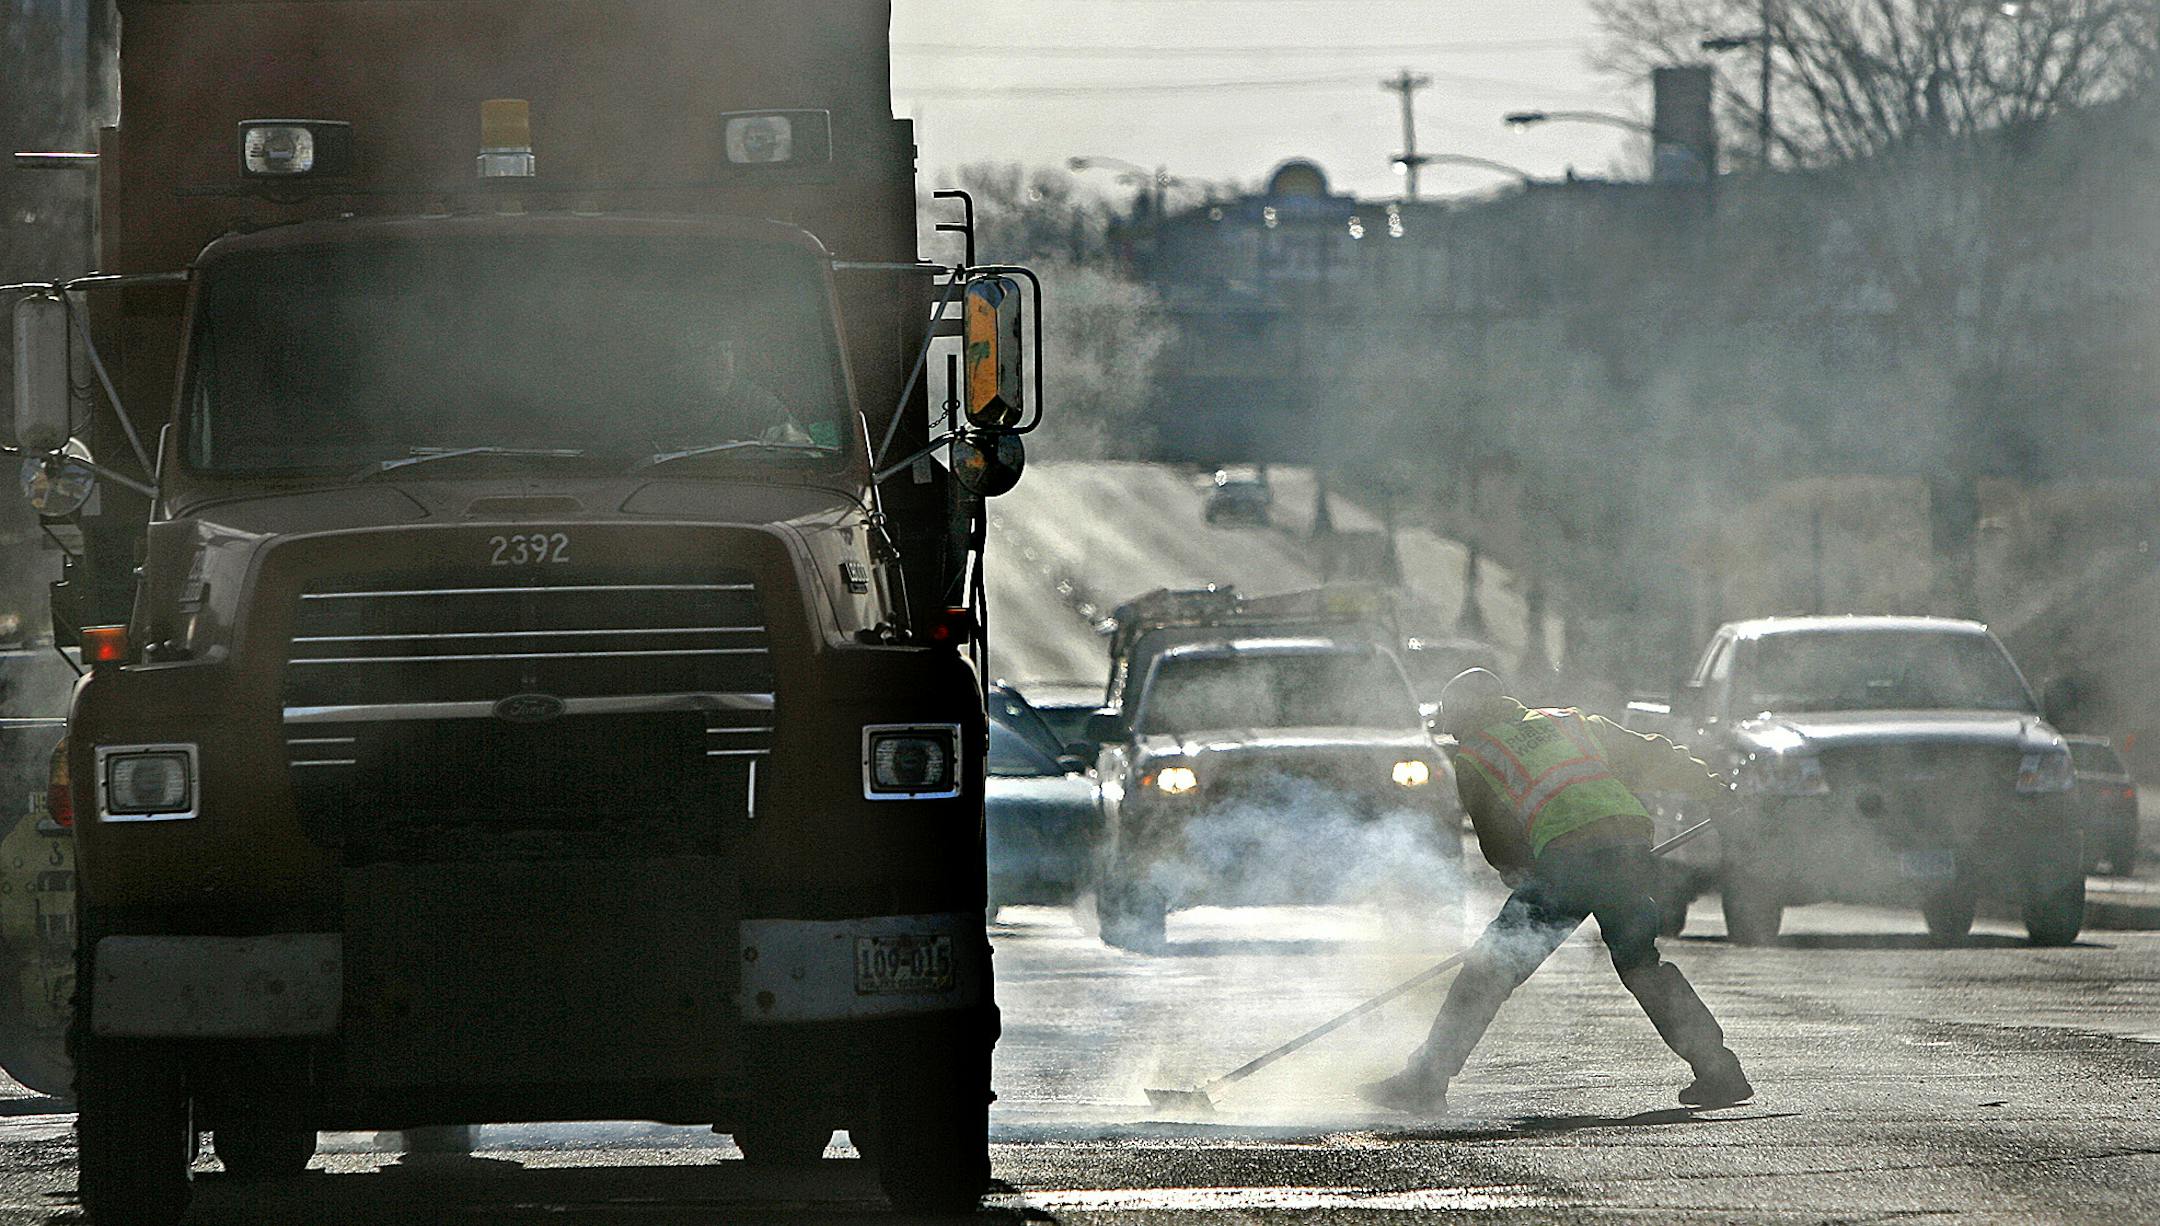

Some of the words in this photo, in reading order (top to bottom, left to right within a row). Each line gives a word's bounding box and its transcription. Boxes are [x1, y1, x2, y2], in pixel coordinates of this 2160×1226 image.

[488, 532, 570, 566] 2392
[1506, 723, 1556, 749] PUBLIC
[861, 944, 950, 978] 109-015
